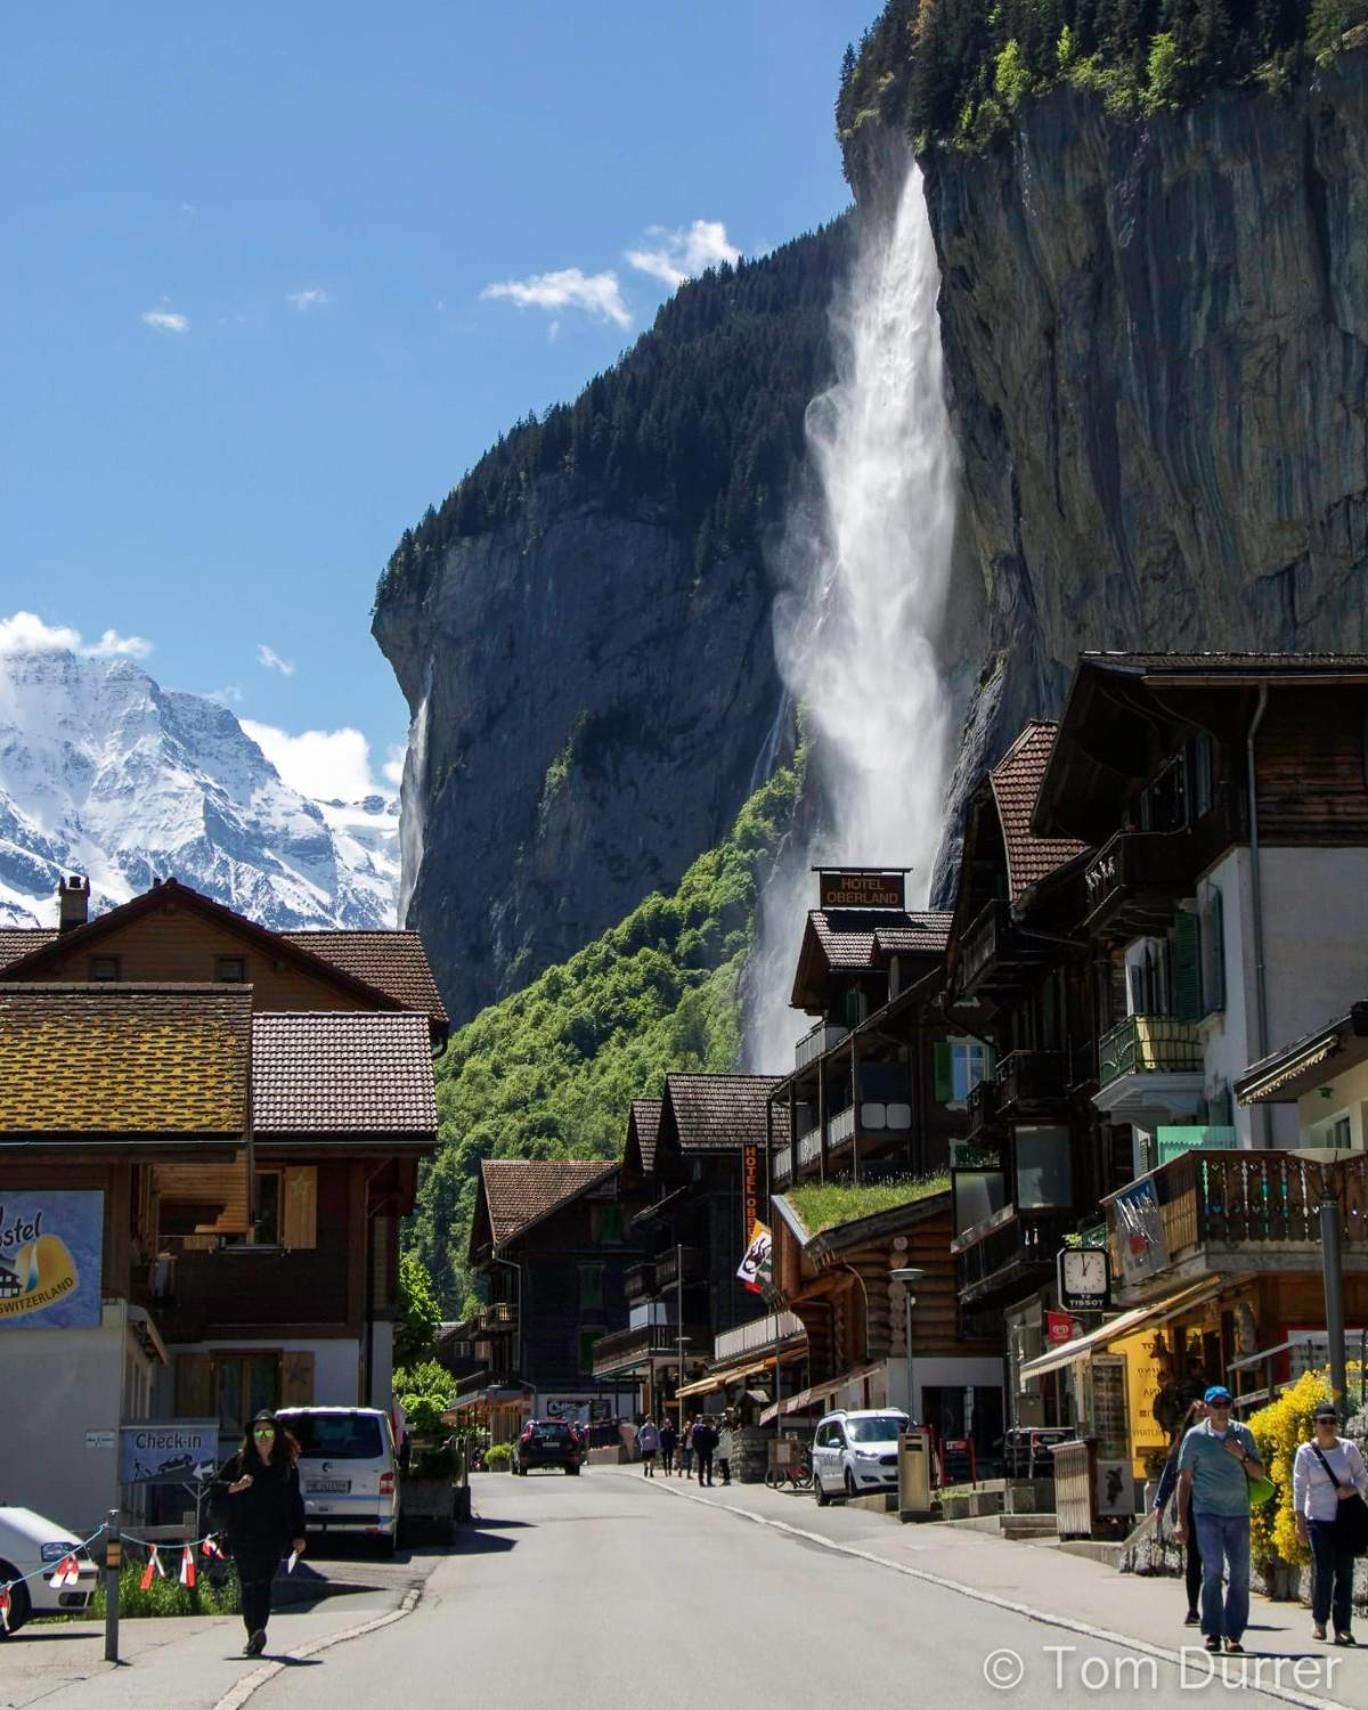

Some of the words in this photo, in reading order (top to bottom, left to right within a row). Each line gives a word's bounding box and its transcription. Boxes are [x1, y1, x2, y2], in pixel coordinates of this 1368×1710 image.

[841, 877, 884, 890] HOTEL
[826, 891, 898, 904] OBERLAND
[746, 1146, 757, 1194] HOTEL
[0, 1211, 42, 1247] stel
[135, 1432, 202, 1449] Check-in
